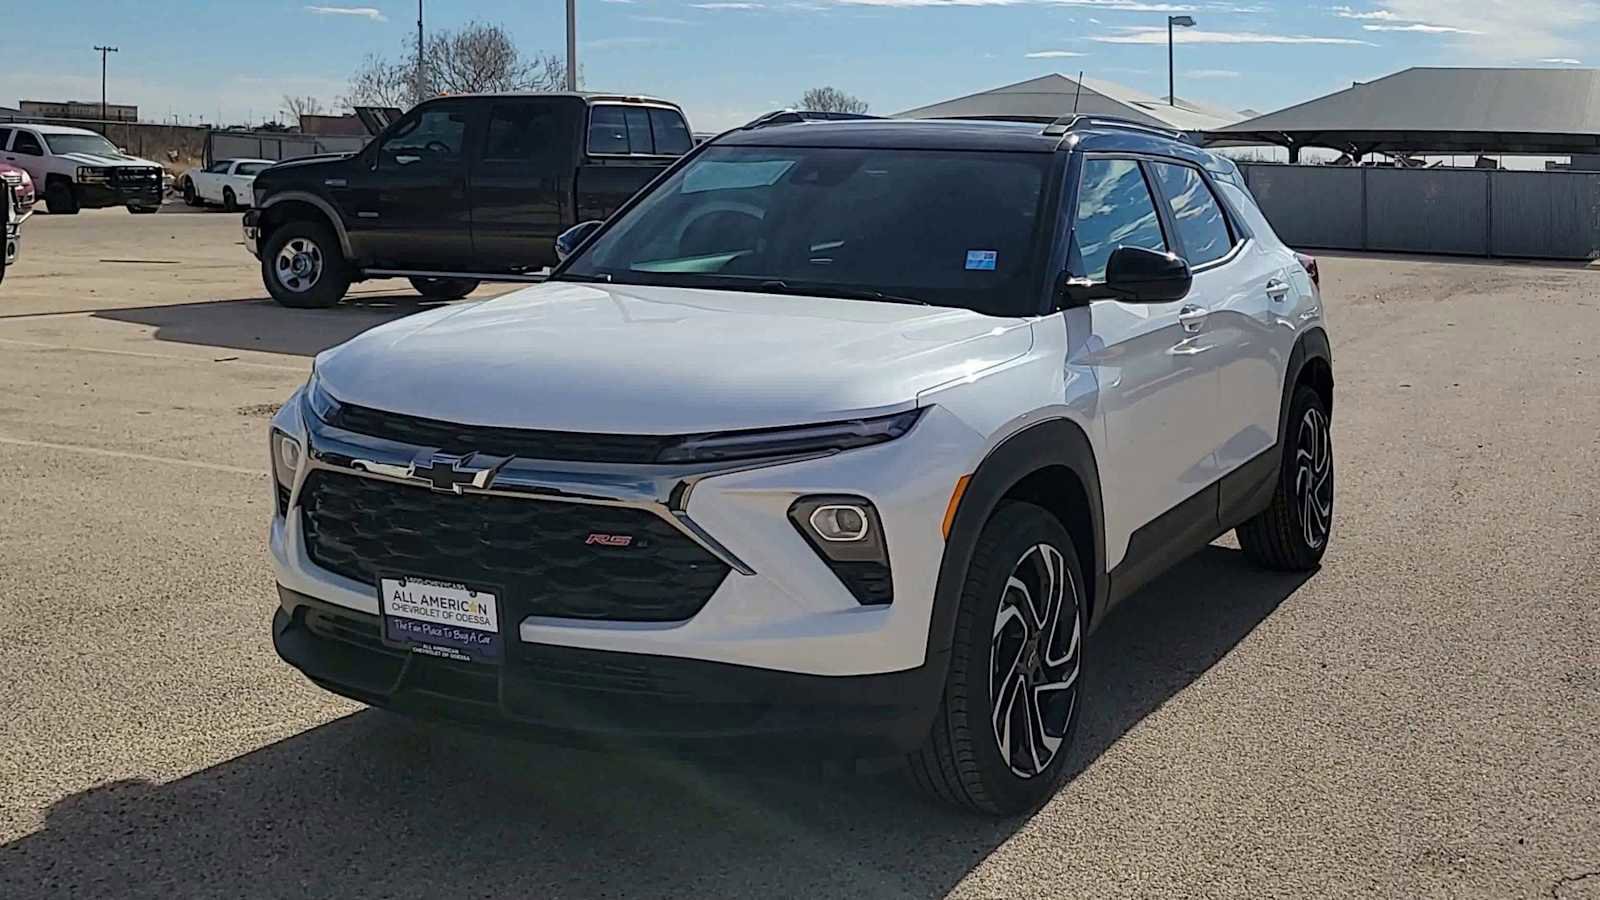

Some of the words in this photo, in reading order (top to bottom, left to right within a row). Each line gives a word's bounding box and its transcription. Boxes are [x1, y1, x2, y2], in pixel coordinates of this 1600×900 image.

[585, 533, 633, 546] RS
[393, 590, 417, 604] ALL
[391, 603, 441, 619] CHEVROLET
[442, 611, 455, 620] OF
[455, 612, 491, 626] ODESSA
[393, 619, 407, 630] The
[442, 628, 452, 638] To
[469, 632, 477, 641] A
[477, 633, 492, 644] Car
